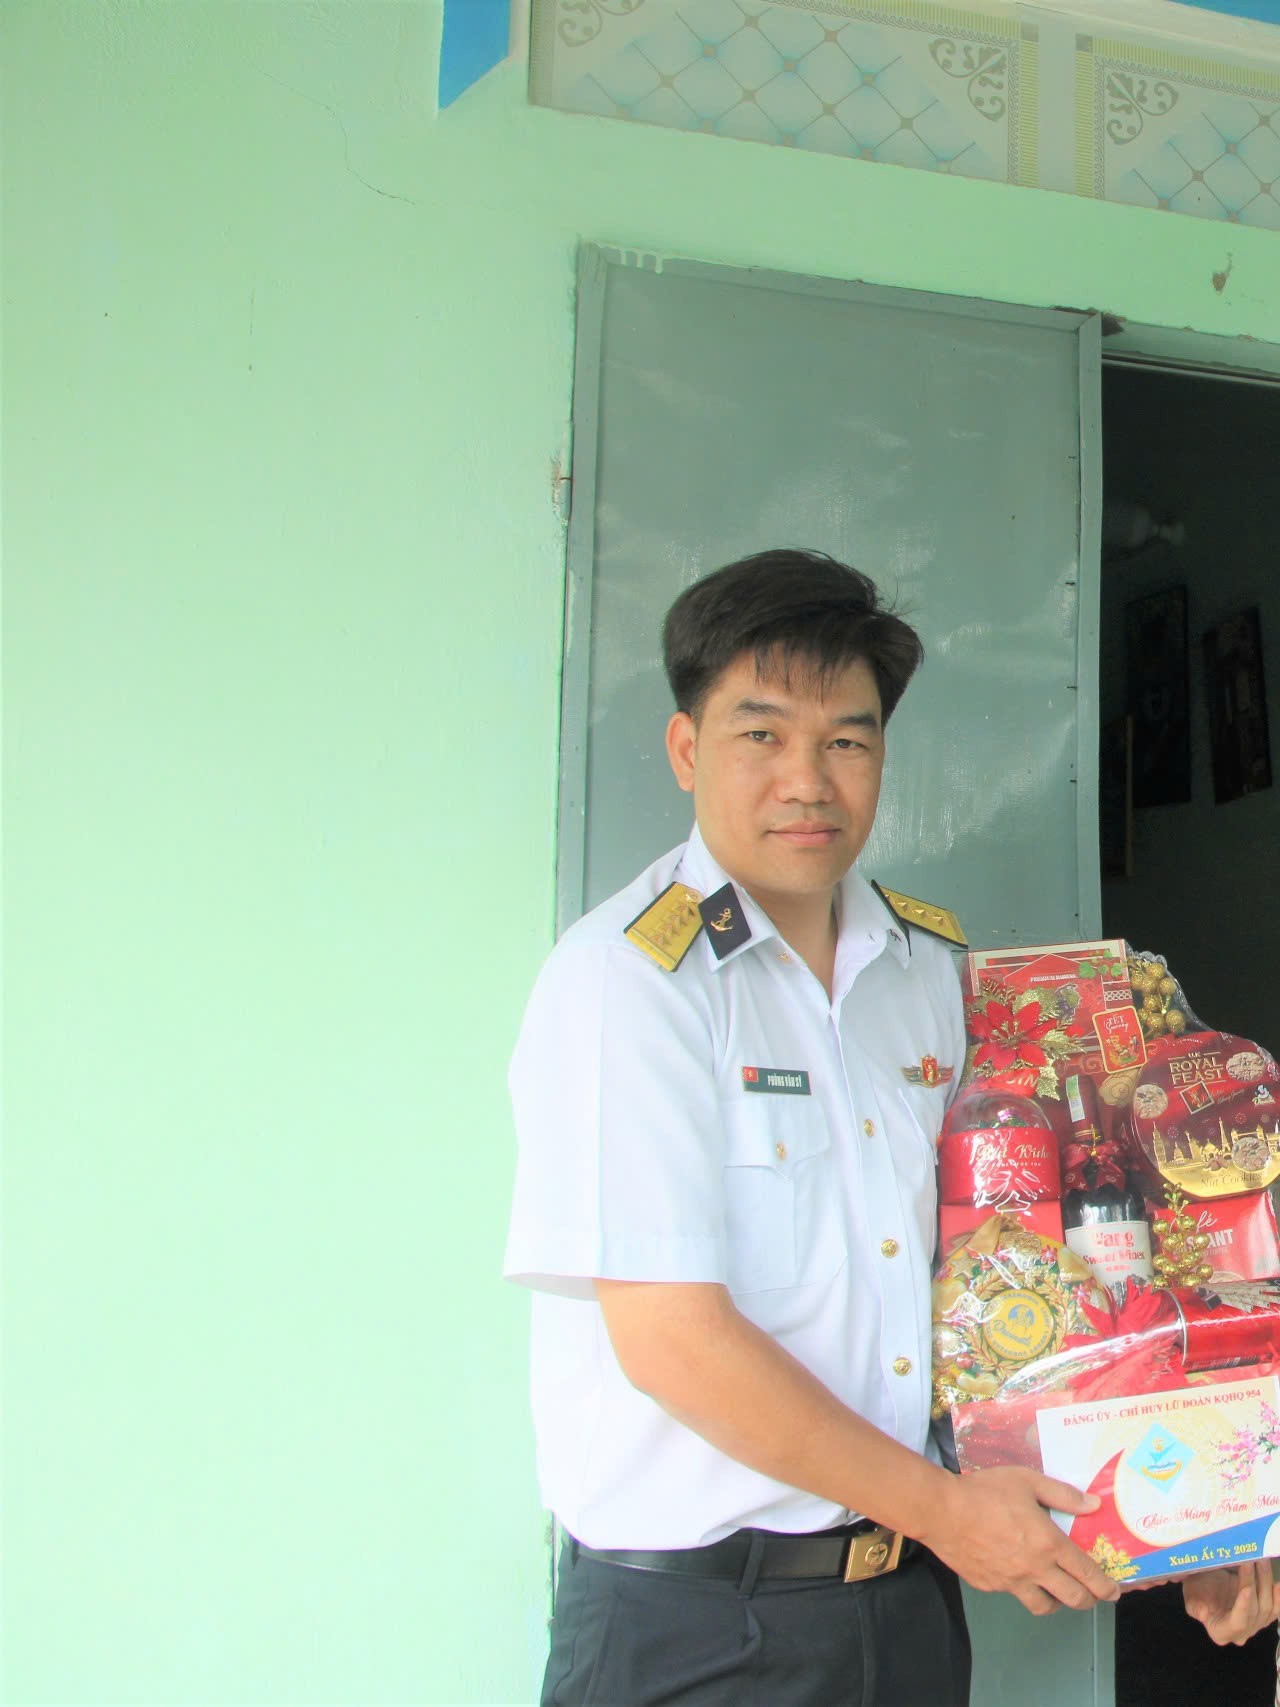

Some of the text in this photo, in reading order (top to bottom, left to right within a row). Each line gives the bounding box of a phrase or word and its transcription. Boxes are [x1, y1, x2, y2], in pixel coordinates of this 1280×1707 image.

[1169, 1056, 1224, 1074] ROYAL
[1171, 1067, 1224, 1085] FEAST
[1201, 1171, 1263, 1188] Nut Cookies
[1063, 1411, 1094, 1427] ĐẢNG
[1096, 1408, 1111, 1422] ỦY
[1119, 1406, 1139, 1419] CHỈ
[1141, 1402, 1164, 1415] HUY
[1166, 1399, 1180, 1411] LỮ
[1182, 1396, 1212, 1410] ĐOÀN
[1214, 1391, 1245, 1406] KQHQ
[1246, 1388, 1261, 1399] 954
[1136, 1494, 1280, 1530] Chúc Mừng Năm Mới
[1169, 1542, 1258, 1567] Xuân Ất Tỵ 2025
